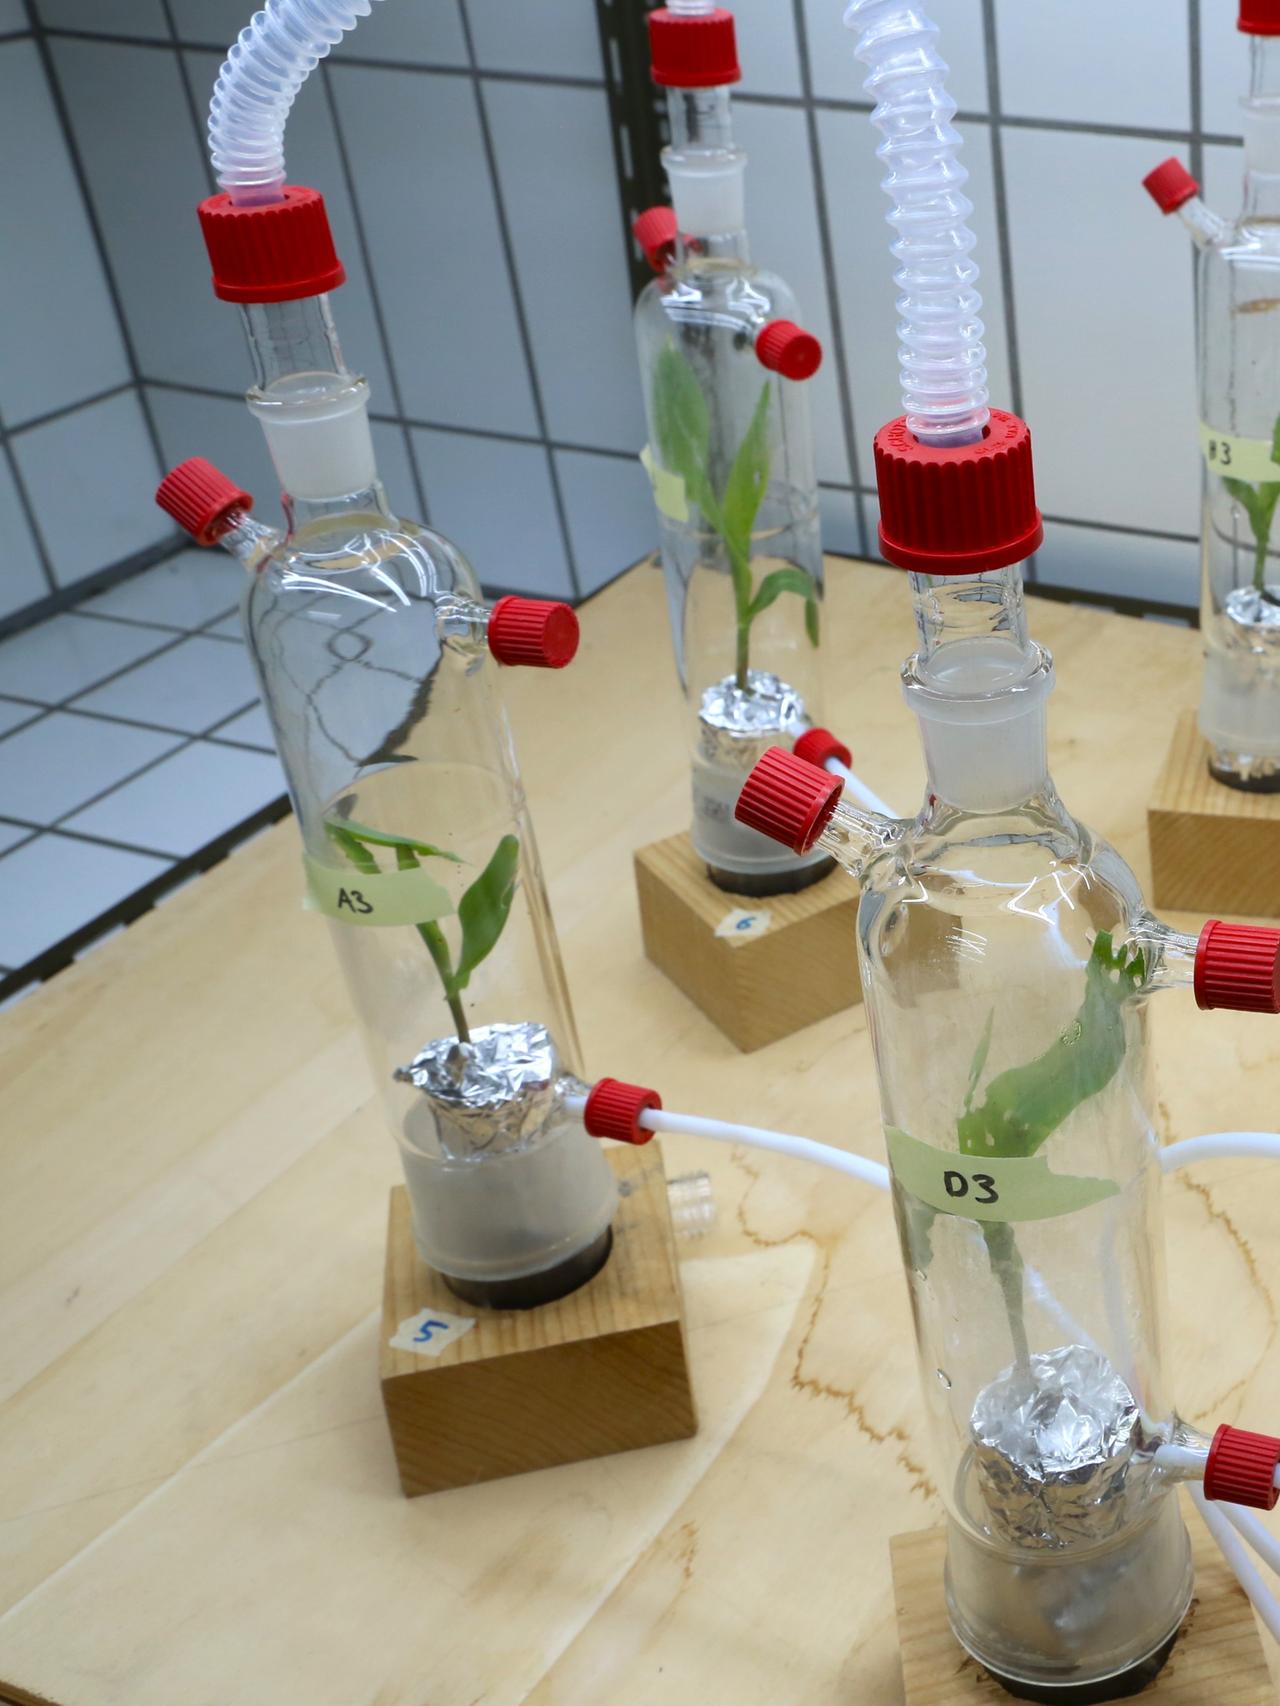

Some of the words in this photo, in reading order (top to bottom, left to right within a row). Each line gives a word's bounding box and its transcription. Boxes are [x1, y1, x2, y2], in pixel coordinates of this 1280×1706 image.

[337, 887, 374, 914] A3
[943, 1170, 999, 1204] D3
[413, 1319, 449, 1343] 5
